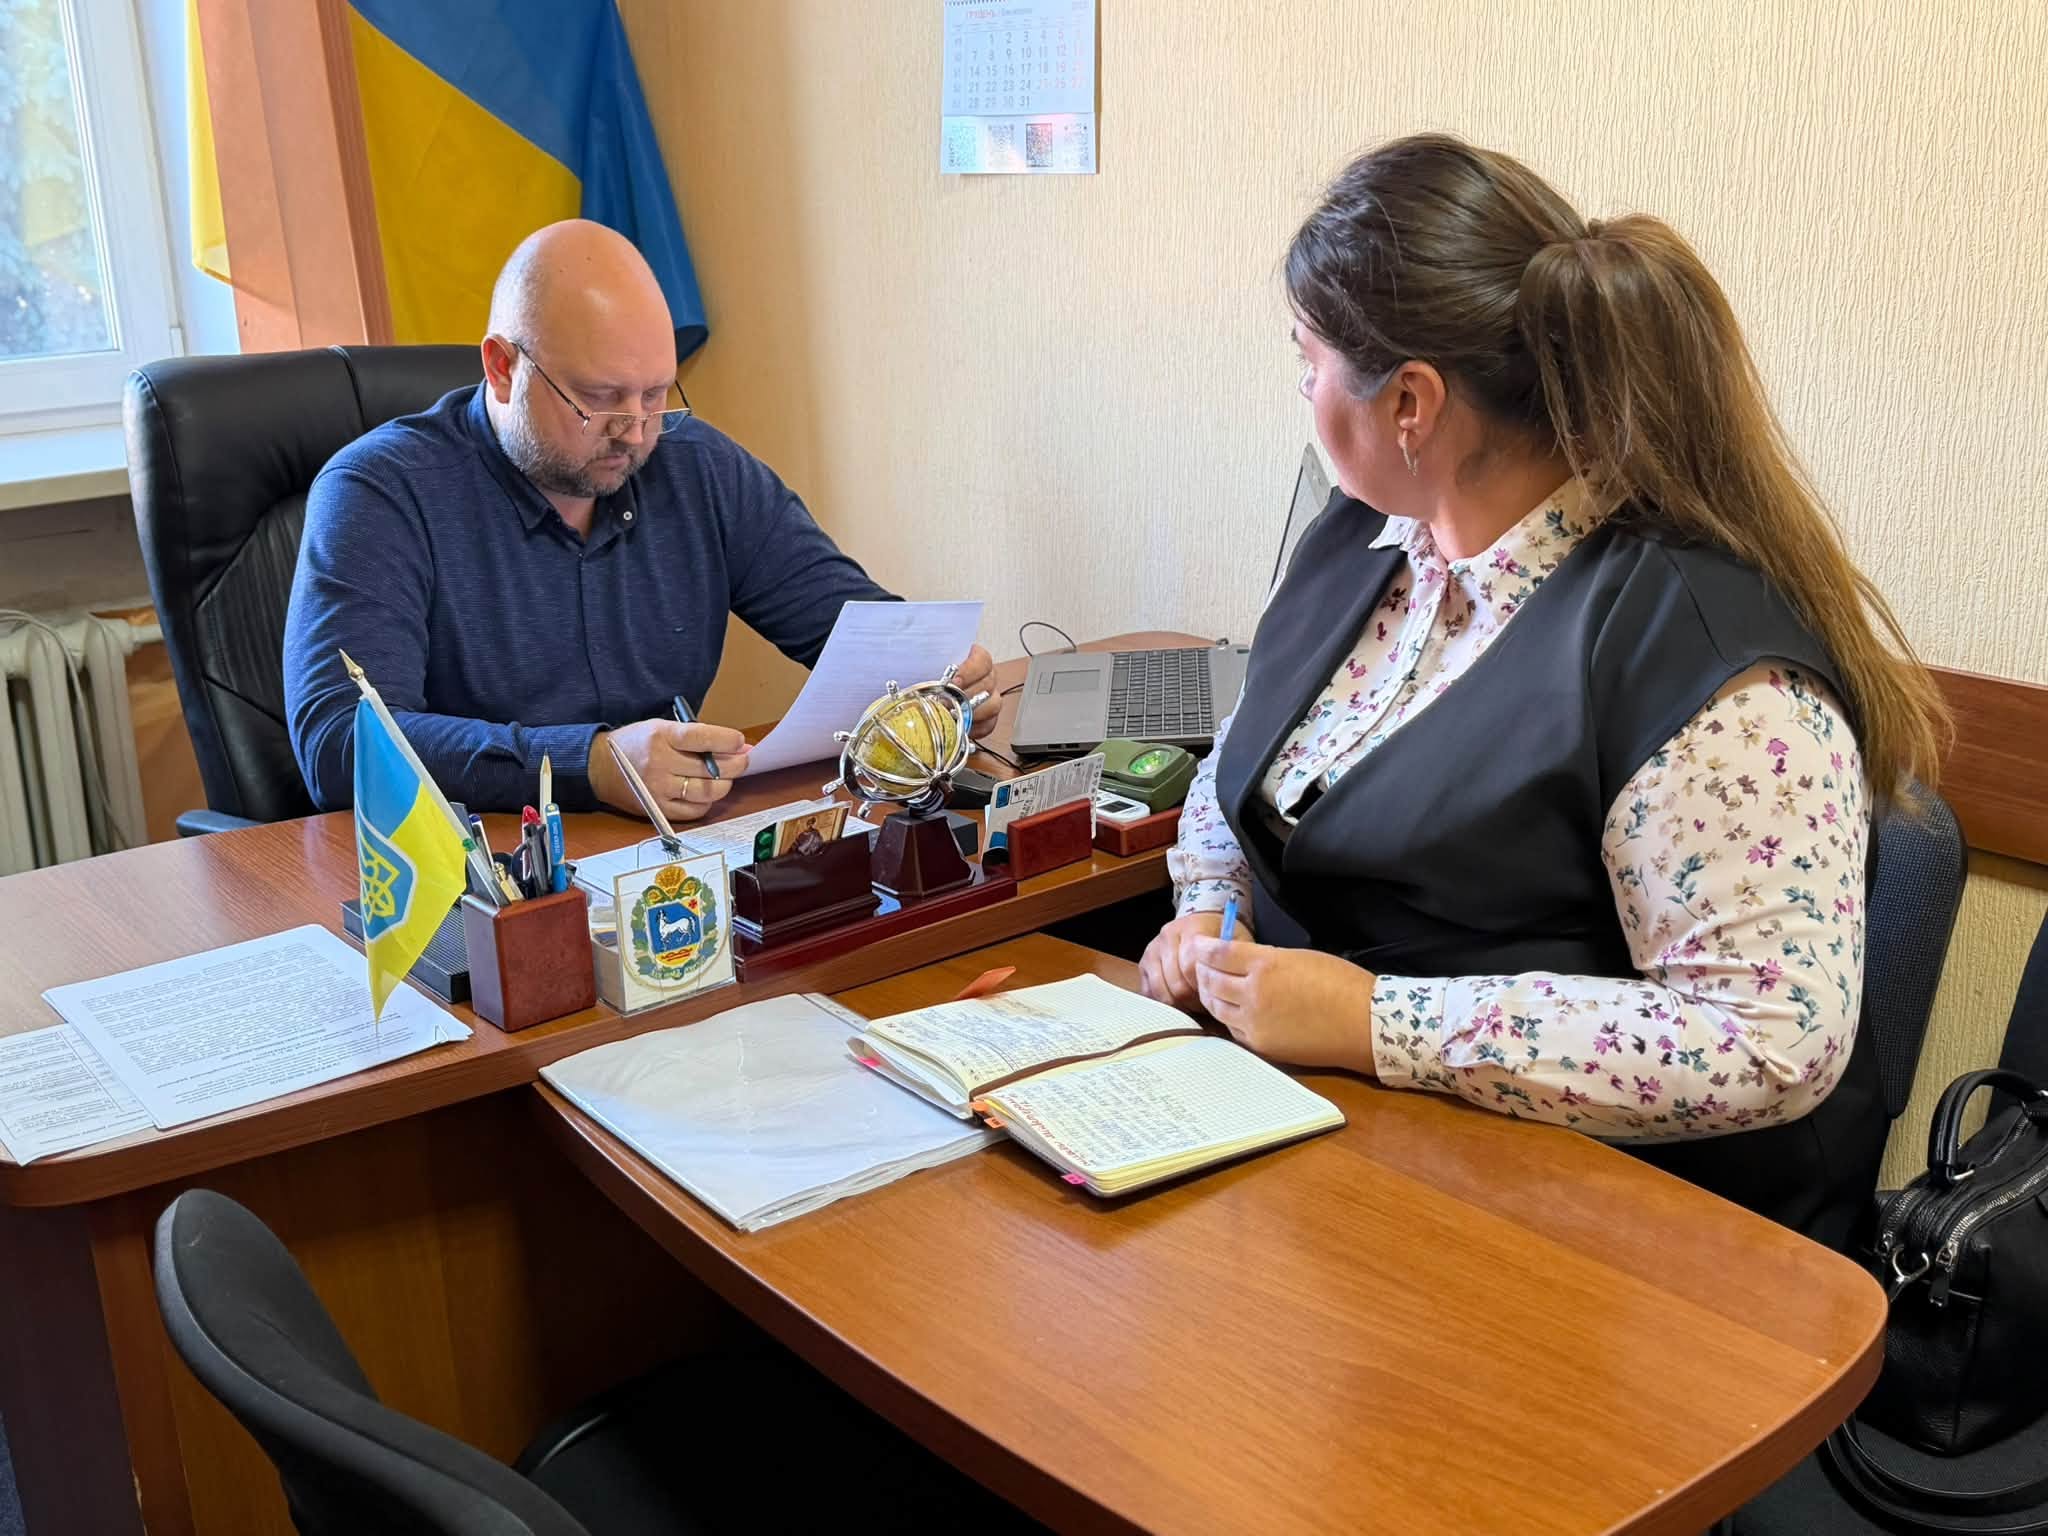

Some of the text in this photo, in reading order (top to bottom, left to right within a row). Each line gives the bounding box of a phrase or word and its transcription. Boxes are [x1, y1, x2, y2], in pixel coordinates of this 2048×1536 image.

[1021, 47, 1032, 59] 10
[969, 66, 980, 77] 14
[986, 65, 997, 77] 15
[1004, 64, 1014, 75] 16
[1021, 63, 1032, 75] 17
[968, 81, 979, 93] 21
[1002, 80, 1015, 92] 23
[1019, 79, 1031, 91] 24
[1019, 95, 1031, 107] 31
